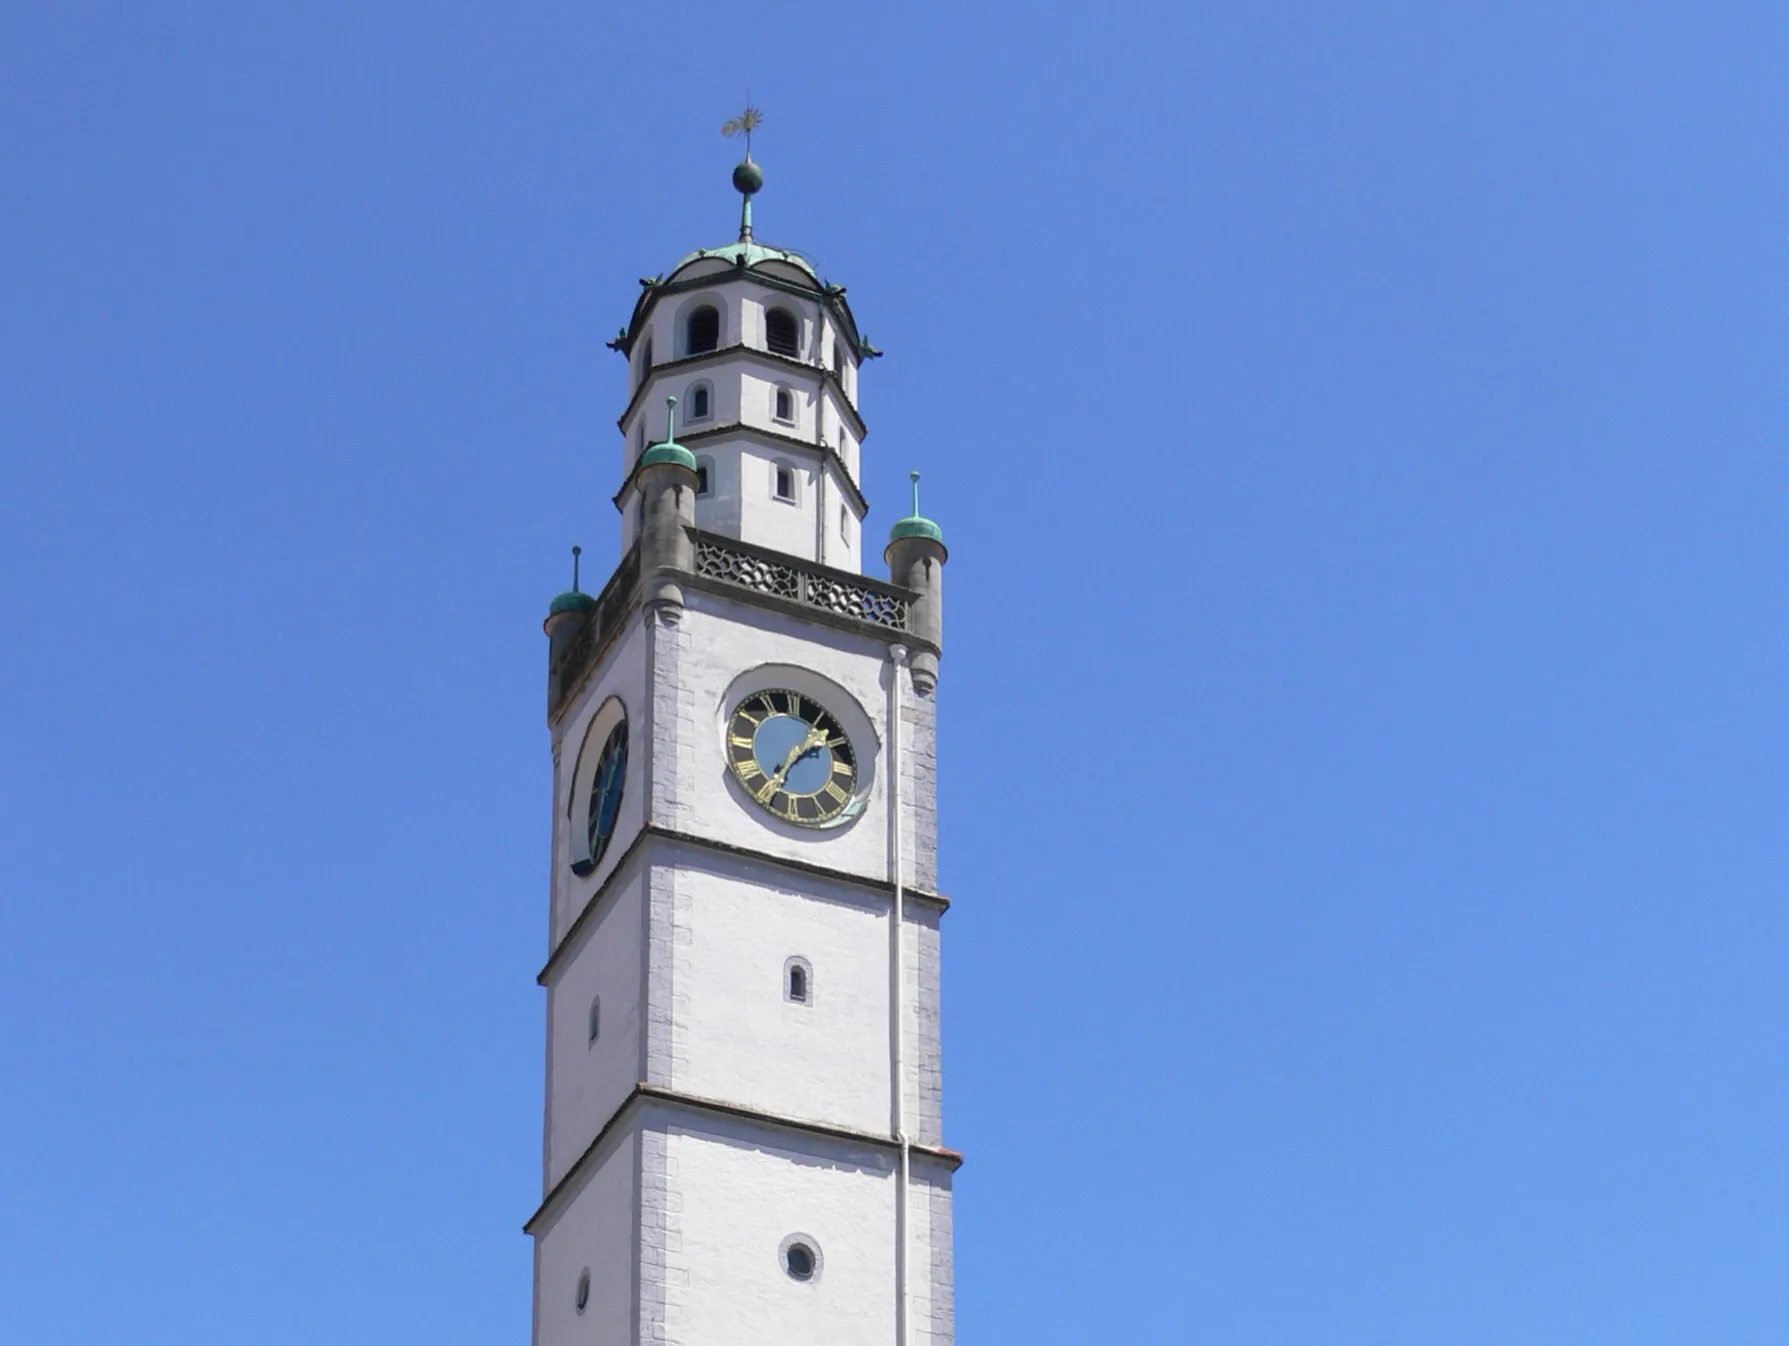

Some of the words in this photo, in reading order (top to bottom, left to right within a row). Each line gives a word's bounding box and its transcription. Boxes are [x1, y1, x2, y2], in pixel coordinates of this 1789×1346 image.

[759, 693, 777, 716] XI
[786, 693, 800, 717] XII
[813, 711, 825, 726] I
[827, 736, 847, 748] II
[736, 760, 761, 781] VIII
[832, 760, 853, 777] III
[787, 793, 799, 819] VI
[812, 794, 828, 818] V
